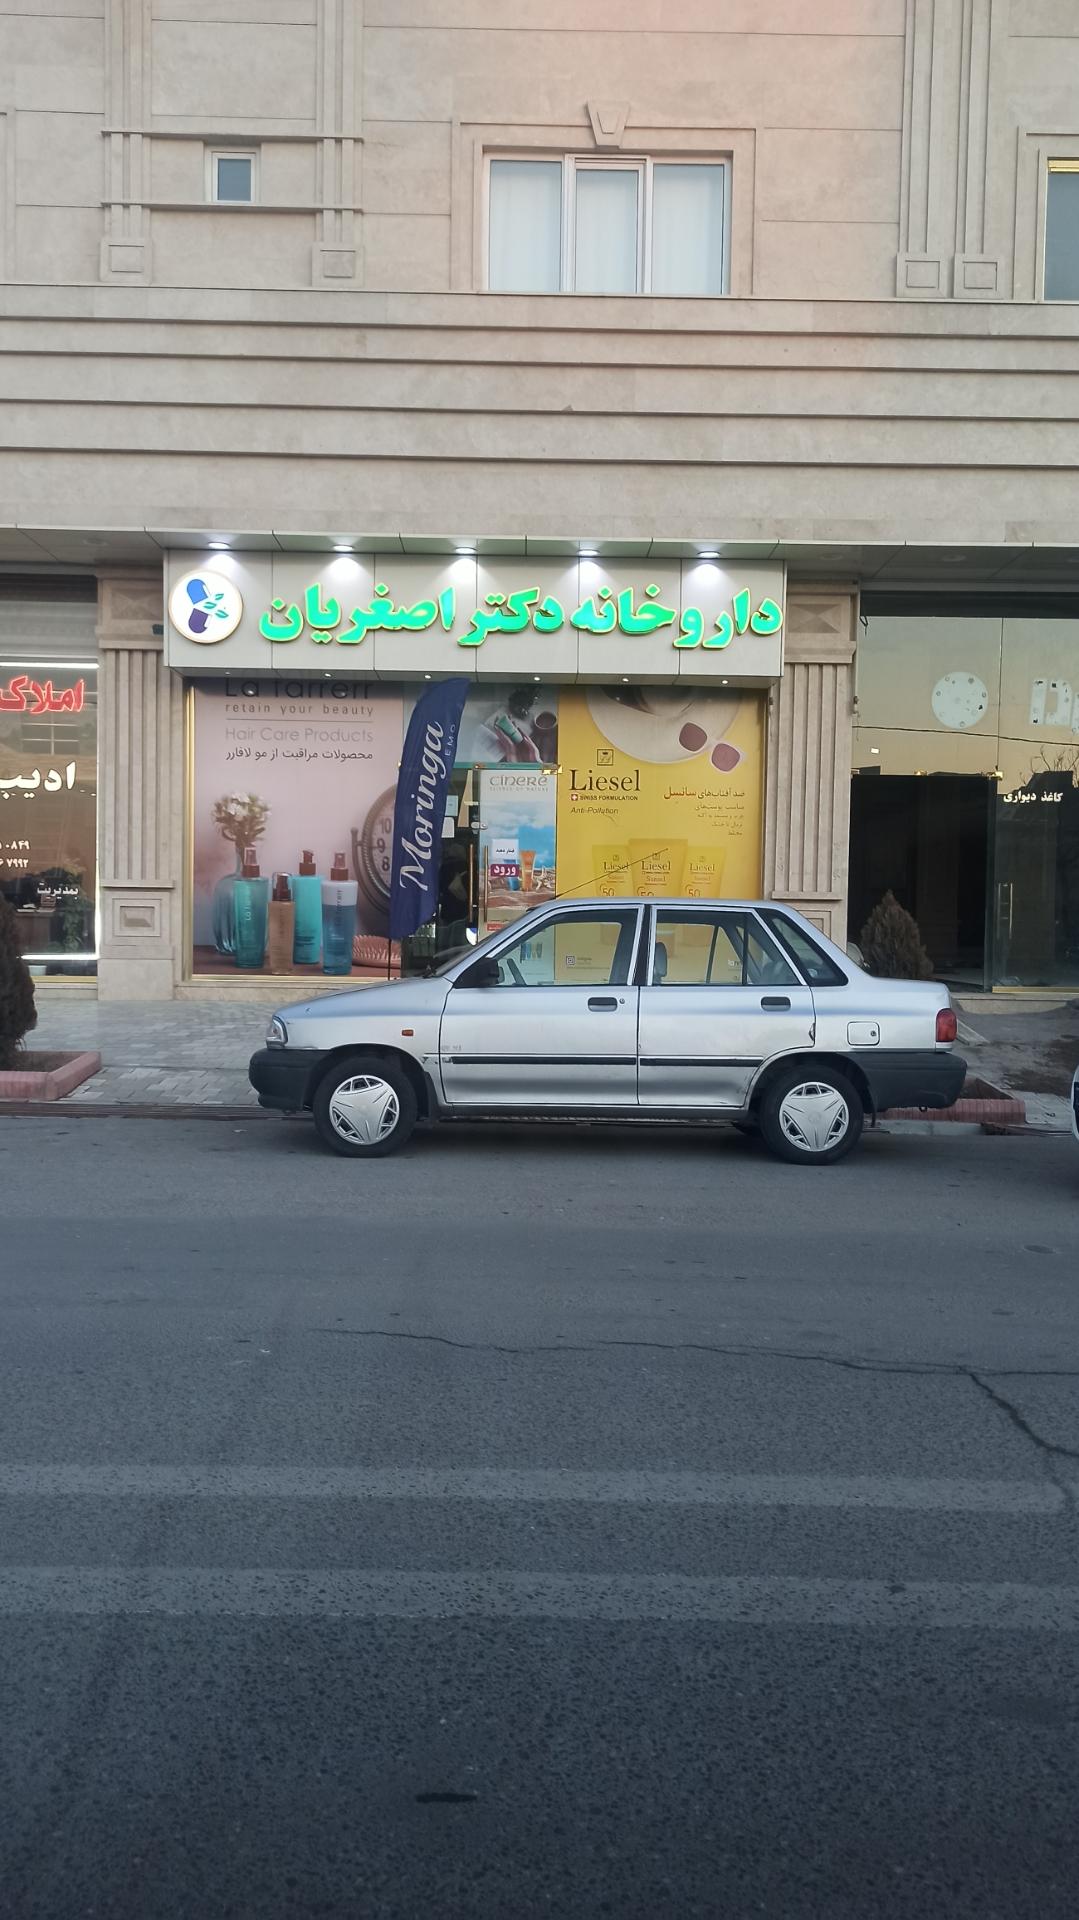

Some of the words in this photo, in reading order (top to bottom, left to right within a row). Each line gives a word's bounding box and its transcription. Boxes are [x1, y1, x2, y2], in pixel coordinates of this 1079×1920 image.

[259, 582, 456, 645] اصغریان
[457, 586, 565, 646] دکتر
[570, 583, 784, 648] داروخانه
[0, 674, 85, 713] املاک
[225, 702, 271, 714] retain
[280, 704, 313, 715] your
[322, 705, 374, 718] beauty
[225, 726, 256, 741] Hair
[260, 726, 300, 741] Care
[304, 727, 374, 742] Products
[225, 747, 251, 760] لافارر
[255, 751, 267, 760] مو
[270, 747, 278, 760] از
[282, 748, 318, 761] مراقبت
[321, 748, 373, 762] محصولات
[569, 769, 641, 791] Liesel
[1003, 789, 1037, 803] دیواری
[1041, 790, 1063, 802] کاغذ
[400, 720, 447, 891] Moringa
[493, 865, 516, 876] ورود
[603, 861, 629, 871] Liesel
[641, 860, 671, 871] Liesel
[689, 863, 715, 872] Liesel
